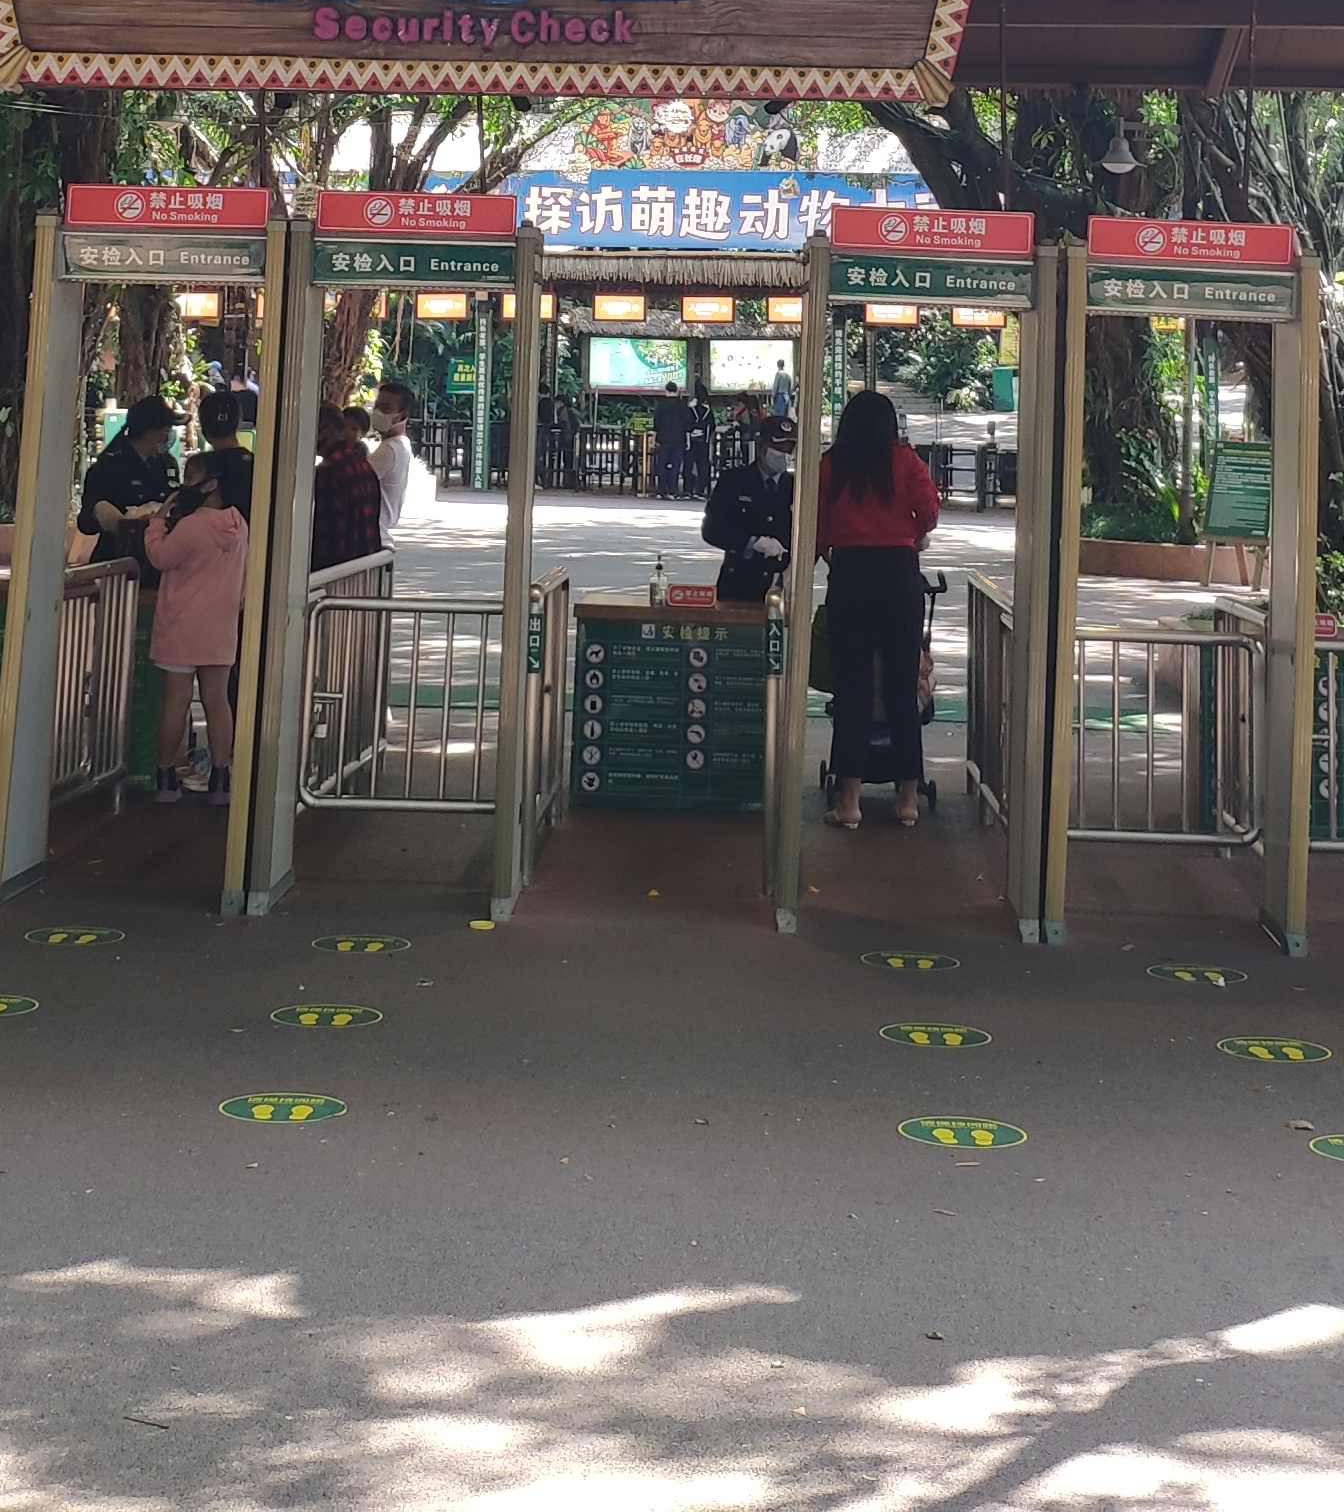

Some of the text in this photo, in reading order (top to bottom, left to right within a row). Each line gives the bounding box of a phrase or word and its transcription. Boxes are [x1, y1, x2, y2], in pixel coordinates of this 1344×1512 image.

[313, 6, 635, 49] Security Check
[150, 191, 223, 210] 禁止吸烟
[398, 198, 471, 217] 禁止吸烟
[152, 210, 218, 224] No Smoking
[401, 217, 466, 230] No Smoking
[912, 215, 986, 235] 禁止吸烟
[915, 234, 981, 248] No Smoking
[1170, 226, 1246, 247] 禁止吸烟
[79, 246, 250, 266] 安检入口 Entrance
[331, 252, 500, 273] 安检入口 Entrance
[1173, 246, 1240, 259] No Smoking
[847, 267, 1016, 291] 安检入口 Entrance
[1103, 279, 1276, 302] 安检入口 Entrance
[529, 617, 541, 648] 出口
[662, 625, 729, 641] 安检提示
[768, 623, 781, 653] 入口
